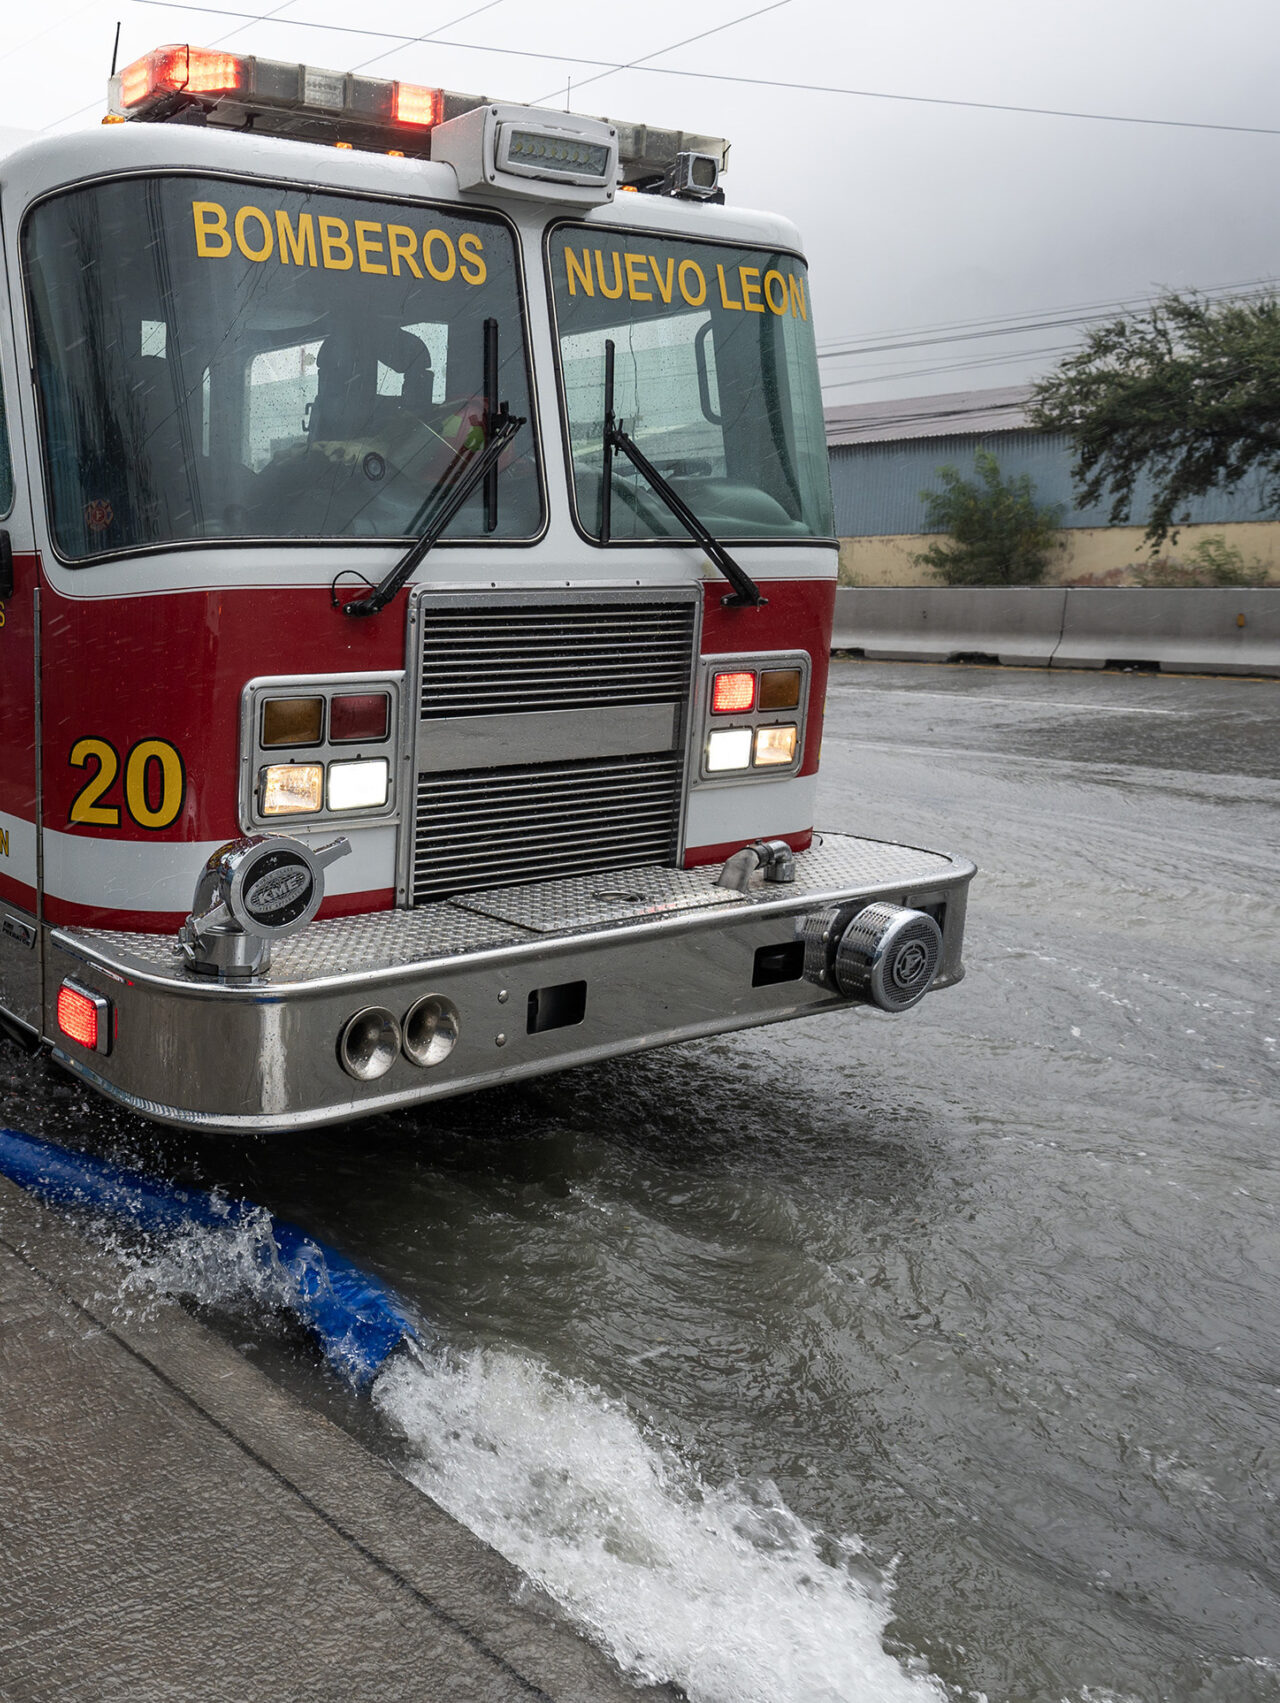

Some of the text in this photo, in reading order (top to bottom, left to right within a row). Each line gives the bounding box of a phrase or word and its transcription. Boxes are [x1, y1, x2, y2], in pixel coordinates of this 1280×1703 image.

[192, 201, 487, 286] BOMBEROS
[564, 246, 808, 321] NUEVO LEON
[68, 735, 187, 831] 20
[257, 877, 299, 905] KME
